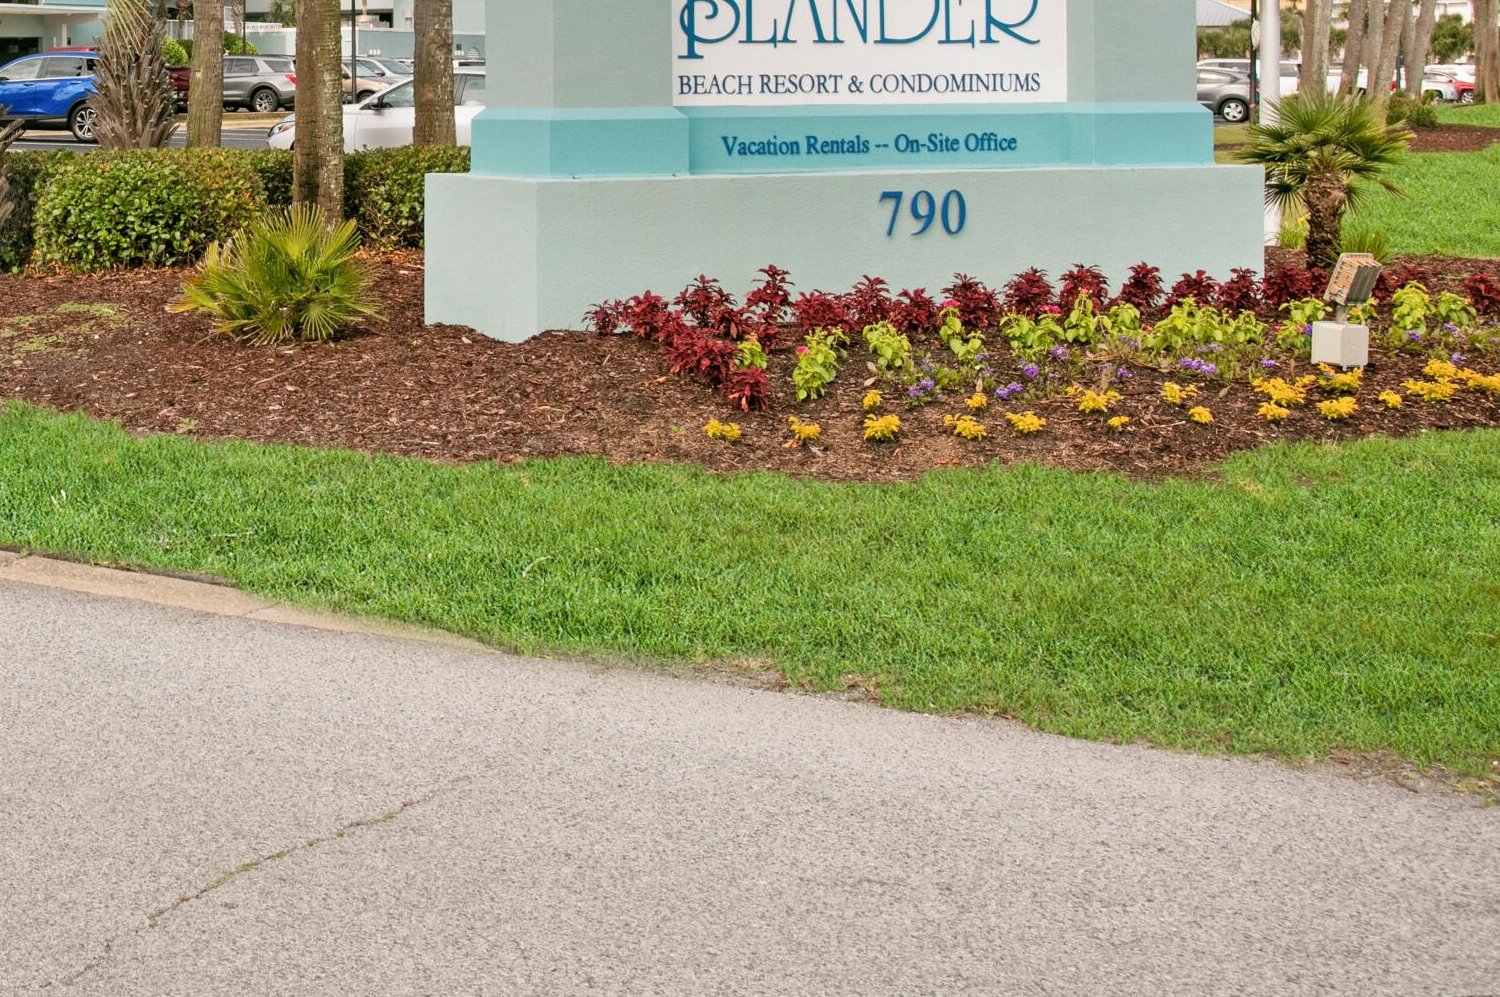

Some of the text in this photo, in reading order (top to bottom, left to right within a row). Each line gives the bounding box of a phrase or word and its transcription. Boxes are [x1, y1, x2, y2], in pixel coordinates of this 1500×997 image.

[678, 72, 1041, 96] BEACH RESORT & CONDOMINIUMS
[722, 135, 800, 156] Vacation
[805, 134, 870, 155] Rentals
[894, 132, 960, 154] On-Site
[964, 132, 1017, 152] Office
[879, 189, 967, 237] 790
